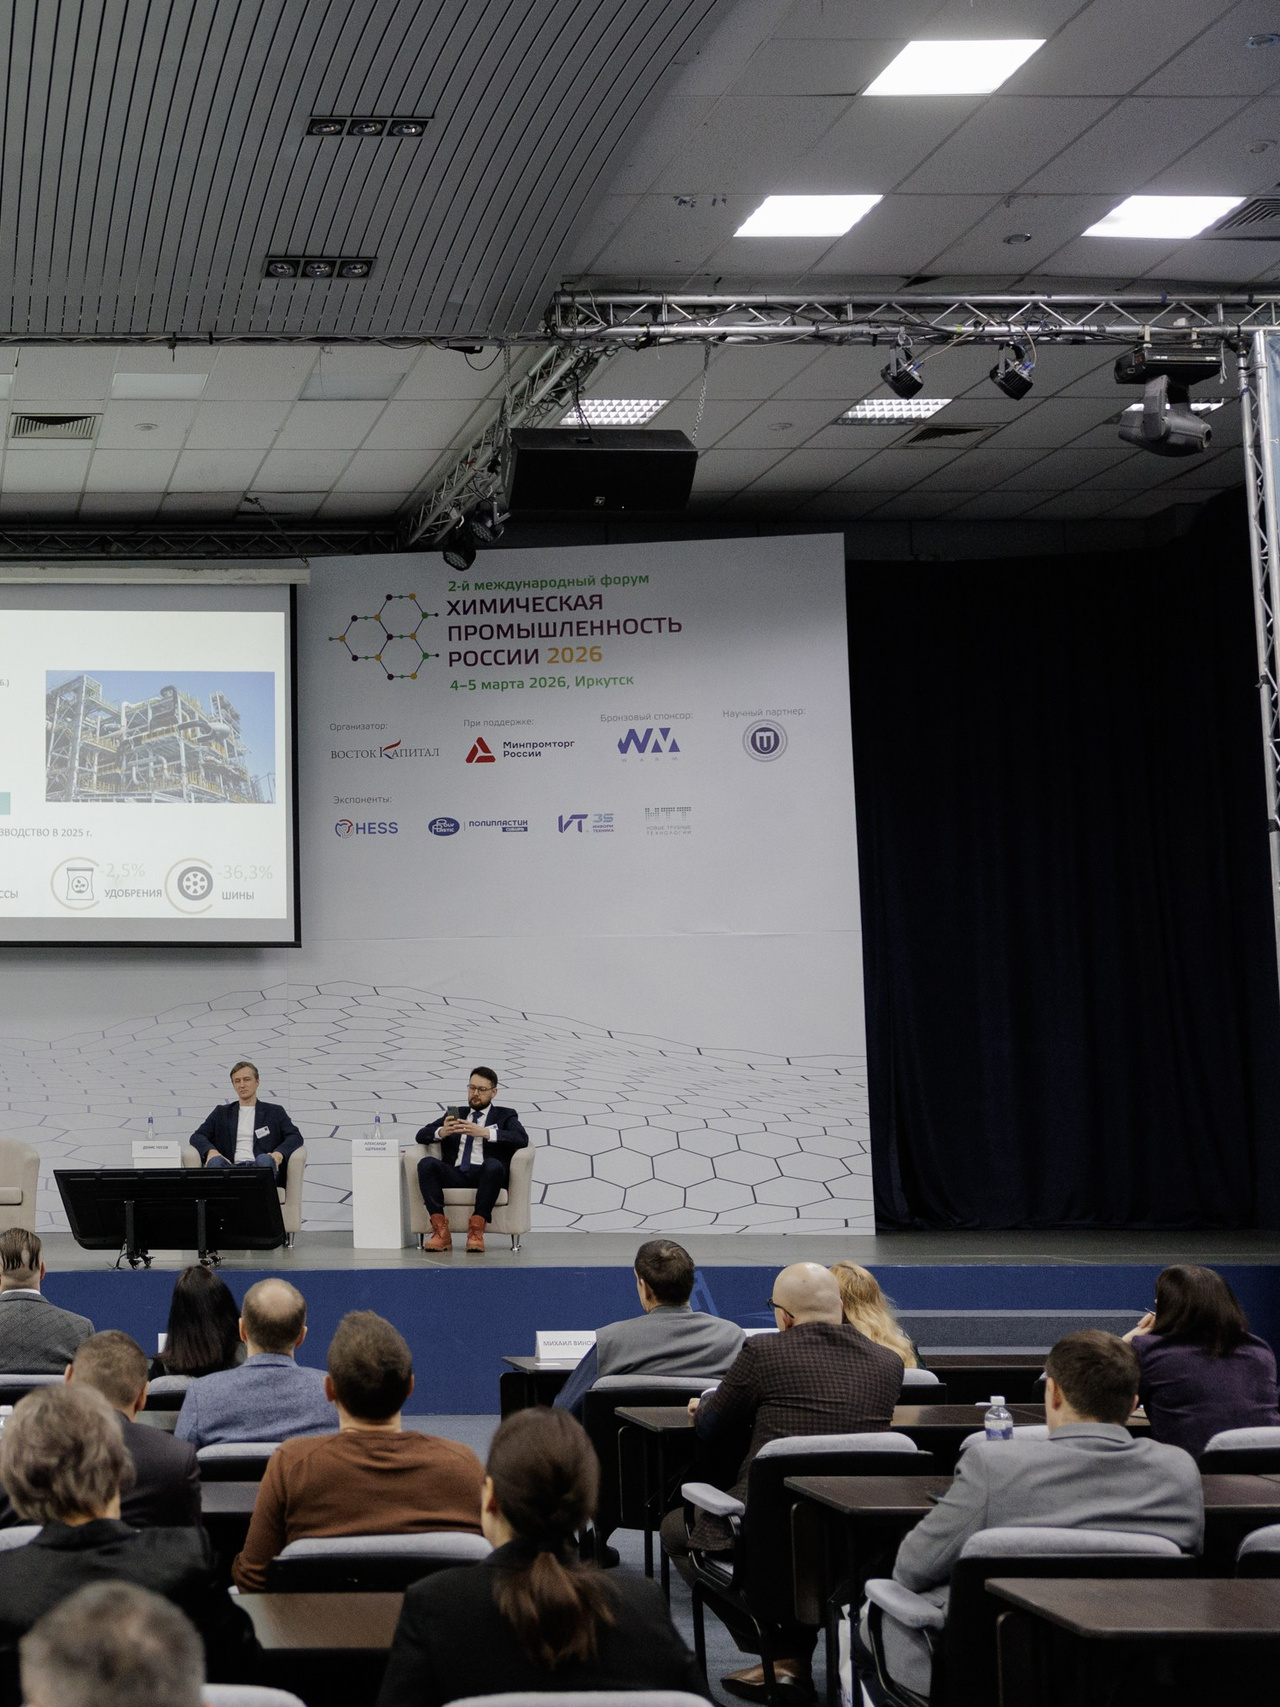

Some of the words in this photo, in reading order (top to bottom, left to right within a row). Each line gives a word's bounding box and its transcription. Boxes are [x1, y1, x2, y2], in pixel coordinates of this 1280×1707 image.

[448, 580, 470, 592] 2-й
[474, 575, 598, 592] международный
[600, 573, 649, 588] форум
[446, 594, 603, 616] ХИМИЧЕСКАЯ
[448, 617, 683, 642] ПРОМЫШЛЕННОСТЬ
[449, 648, 540, 667] РОССИИ
[546, 646, 603, 665] 2026
[481, 679, 525, 691] марта
[529, 676, 571, 690] 2026,
[575, 674, 634, 688] Иркутск
[600, 712, 652, 723] Бронзовый
[654, 711, 694, 722] спонсор:
[722, 709, 762, 719] Научный
[766, 707, 807, 717] партнер:
[330, 722, 388, 732] Организатор:
[464, 719, 481, 728] При
[483, 717, 534, 728] поддержке:
[331, 748, 376, 759] ВОСТОК
[379, 739, 440, 759] КАПИТАЛ
[503, 740, 576, 751] Минпромторг
[503, 750, 542, 758] России
[333, 795, 393, 804] Экспоненты:
[52, 829, 59, 837] В
[60, 828, 84, 837] 2025
[355, 821, 399, 835] HESS
[104, 888, 162, 898] УДОБРЕНИЯ
[221, 891, 255, 900] ШИНЫ
